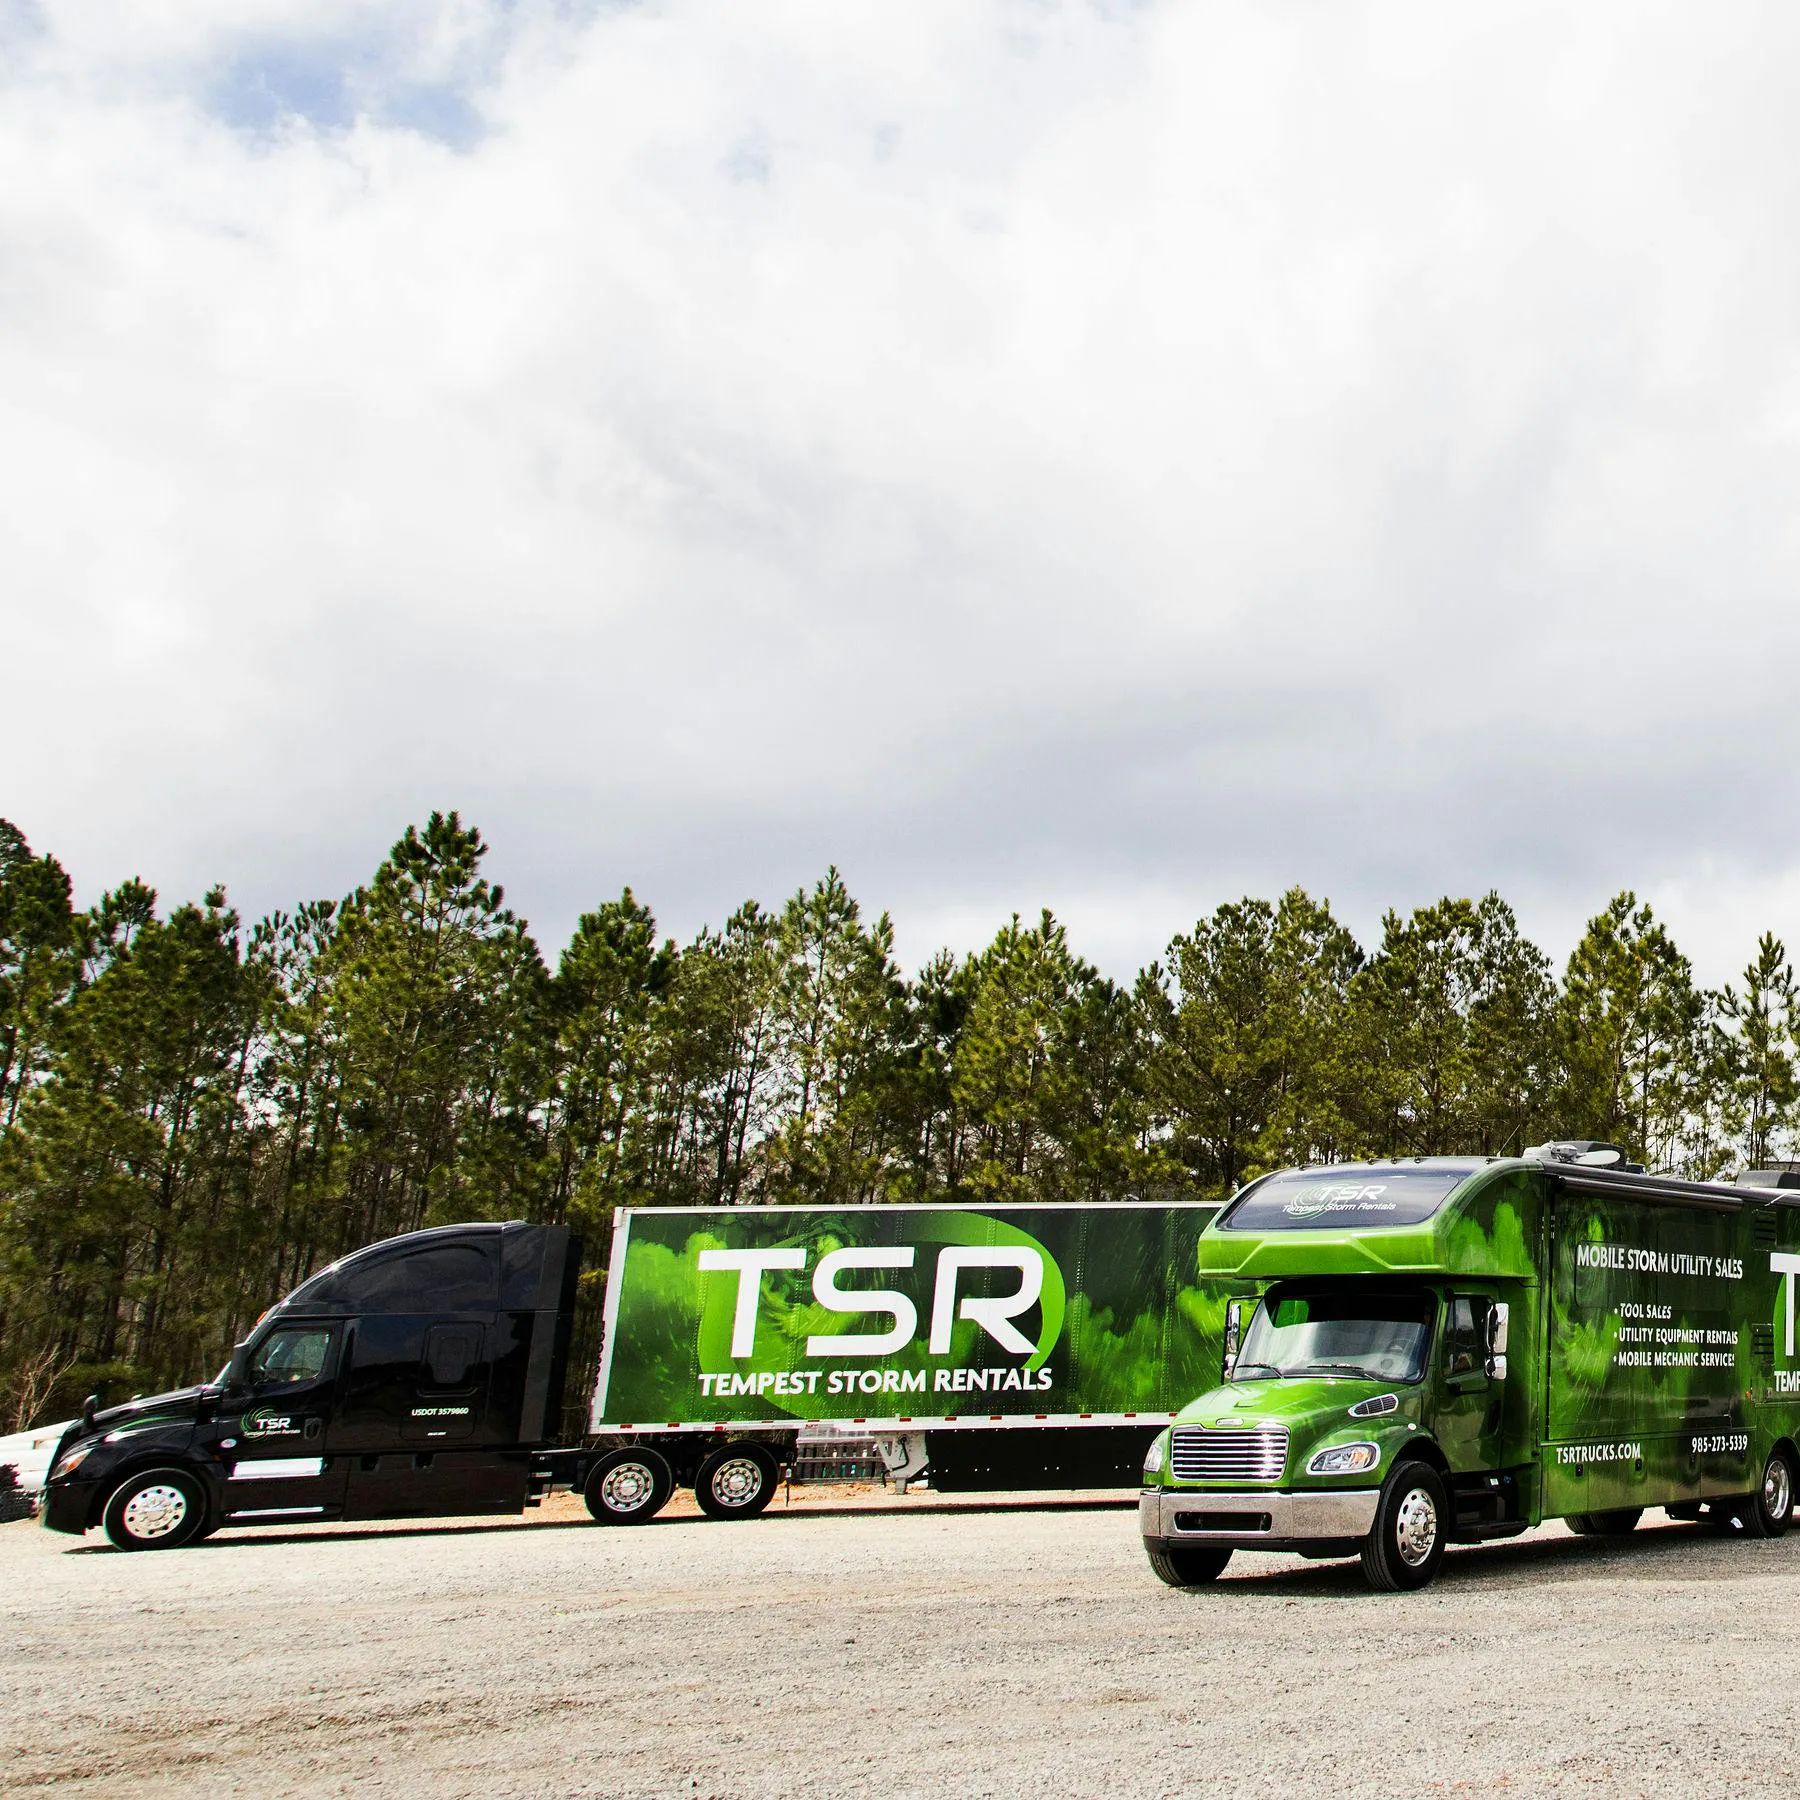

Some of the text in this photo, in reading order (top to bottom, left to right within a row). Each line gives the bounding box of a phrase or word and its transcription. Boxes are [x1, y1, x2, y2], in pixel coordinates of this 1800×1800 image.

[1319, 1185, 1387, 1200] TSR
[1282, 1202, 1397, 1213] Tempest Storm Rentals
[1576, 1244, 1743, 1280] MOBILE STORM UTILITY SALES
[699, 1246, 1042, 1358] TSR
[1620, 1302, 1672, 1320] TOOL SALES
[1619, 1327, 1653, 1343] UTILITY
[1655, 1328, 1705, 1345] EQUIPMENT
[1618, 1352, 1652, 1367] MOBILE
[1654, 1352, 1699, 1367] MECHANIC
[698, 1368, 1053, 1397] TEMPEST STORM RENTALS
[256, 1418, 291, 1429] TSR
[1691, 1434, 1748, 1454] 985-273-5339
[1556, 1443, 1641, 1464] TSRTRUCKS.COM
